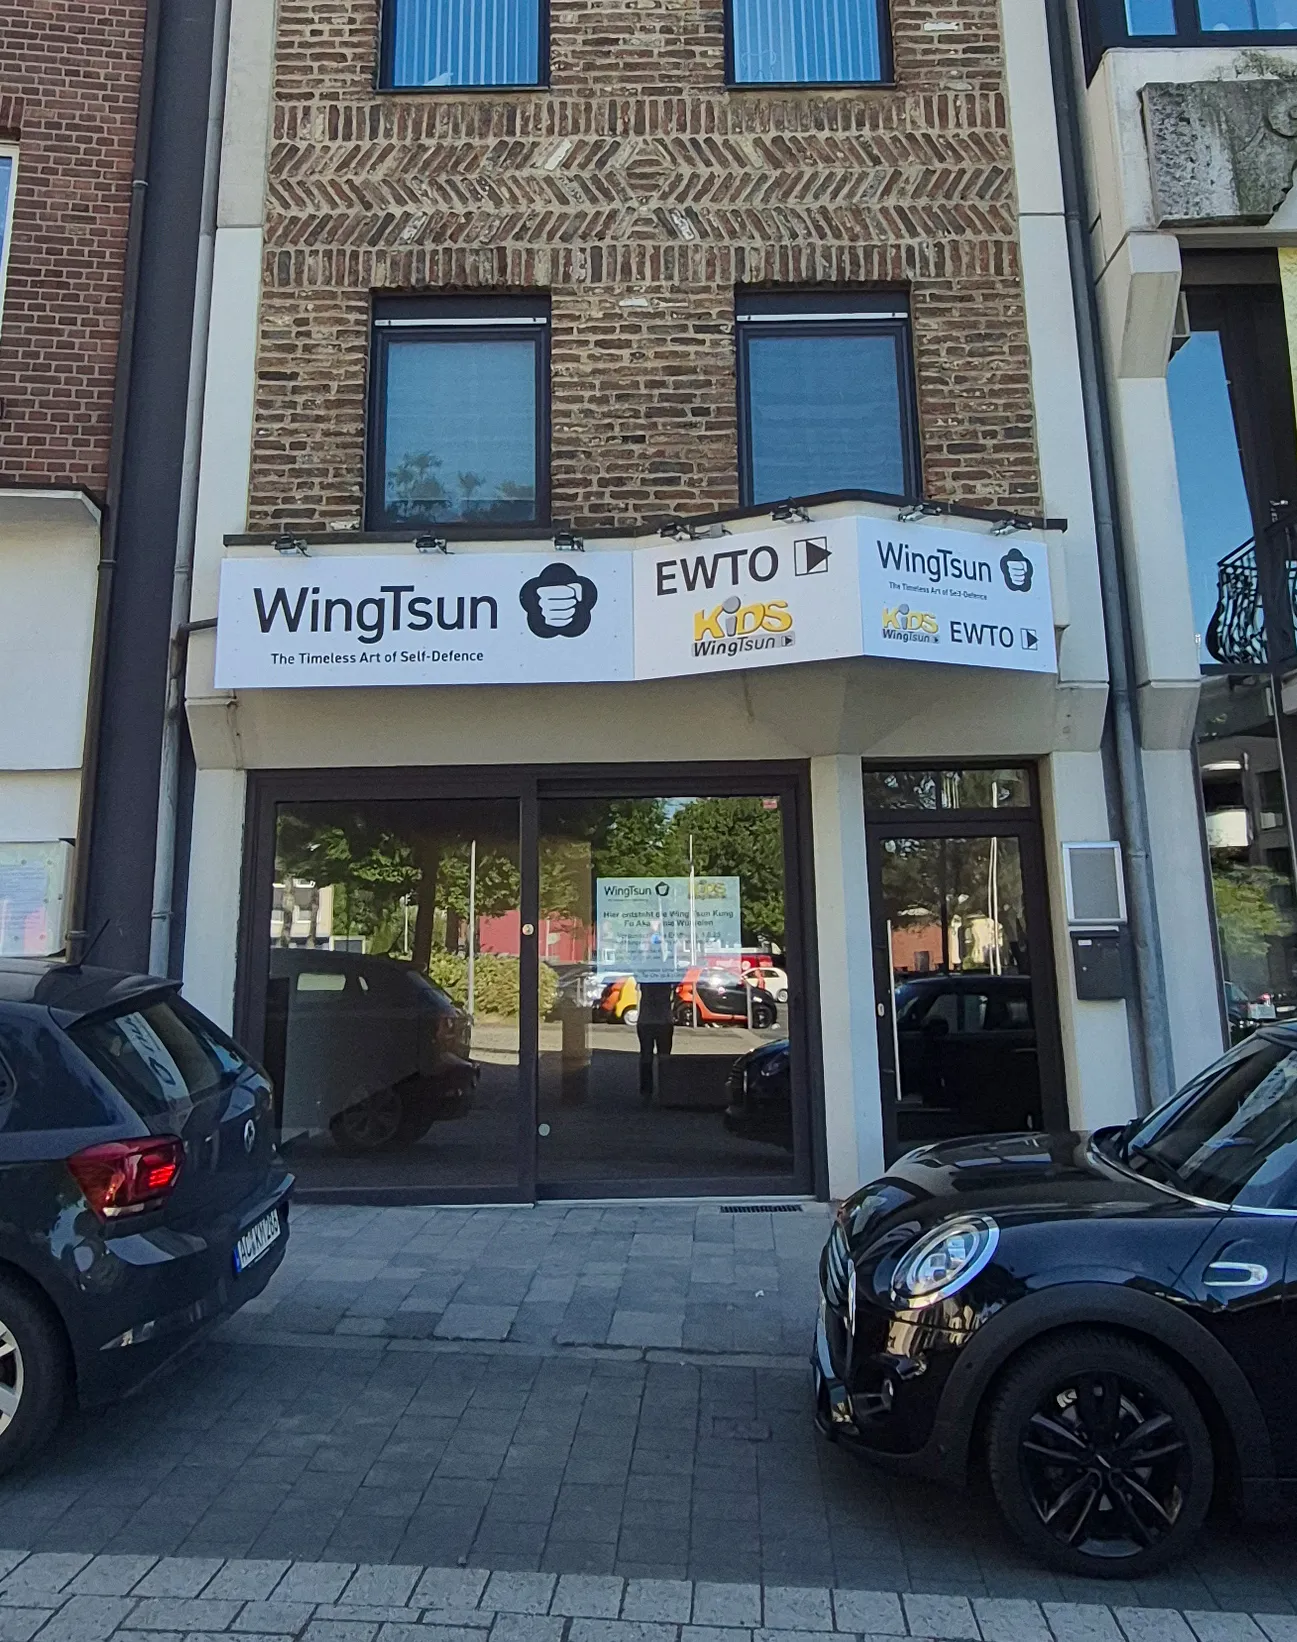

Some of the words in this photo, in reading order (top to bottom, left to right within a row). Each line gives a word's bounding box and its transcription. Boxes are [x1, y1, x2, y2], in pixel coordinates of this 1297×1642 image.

[656, 545, 778, 596] EWTO
[876, 540, 993, 583] WingTsun
[888, 581, 901, 590] The
[902, 583, 929, 594] Timeless
[930, 587, 941, 595] Art
[942, 588, 948, 596] of
[253, 585, 498, 644] WingTsun
[882, 628, 930, 643] WingTsun
[950, 621, 1014, 648] EWTO
[694, 636, 776, 657] WingTsun
[271, 653, 295, 665] The
[299, 652, 356, 664] Timeless
[360, 652, 380, 664] Art
[385, 651, 397, 663] of
[400, 650, 483, 663] Self-Defence
[604, 886, 652, 898] WingTsun
[655, 911, 667, 919] de
